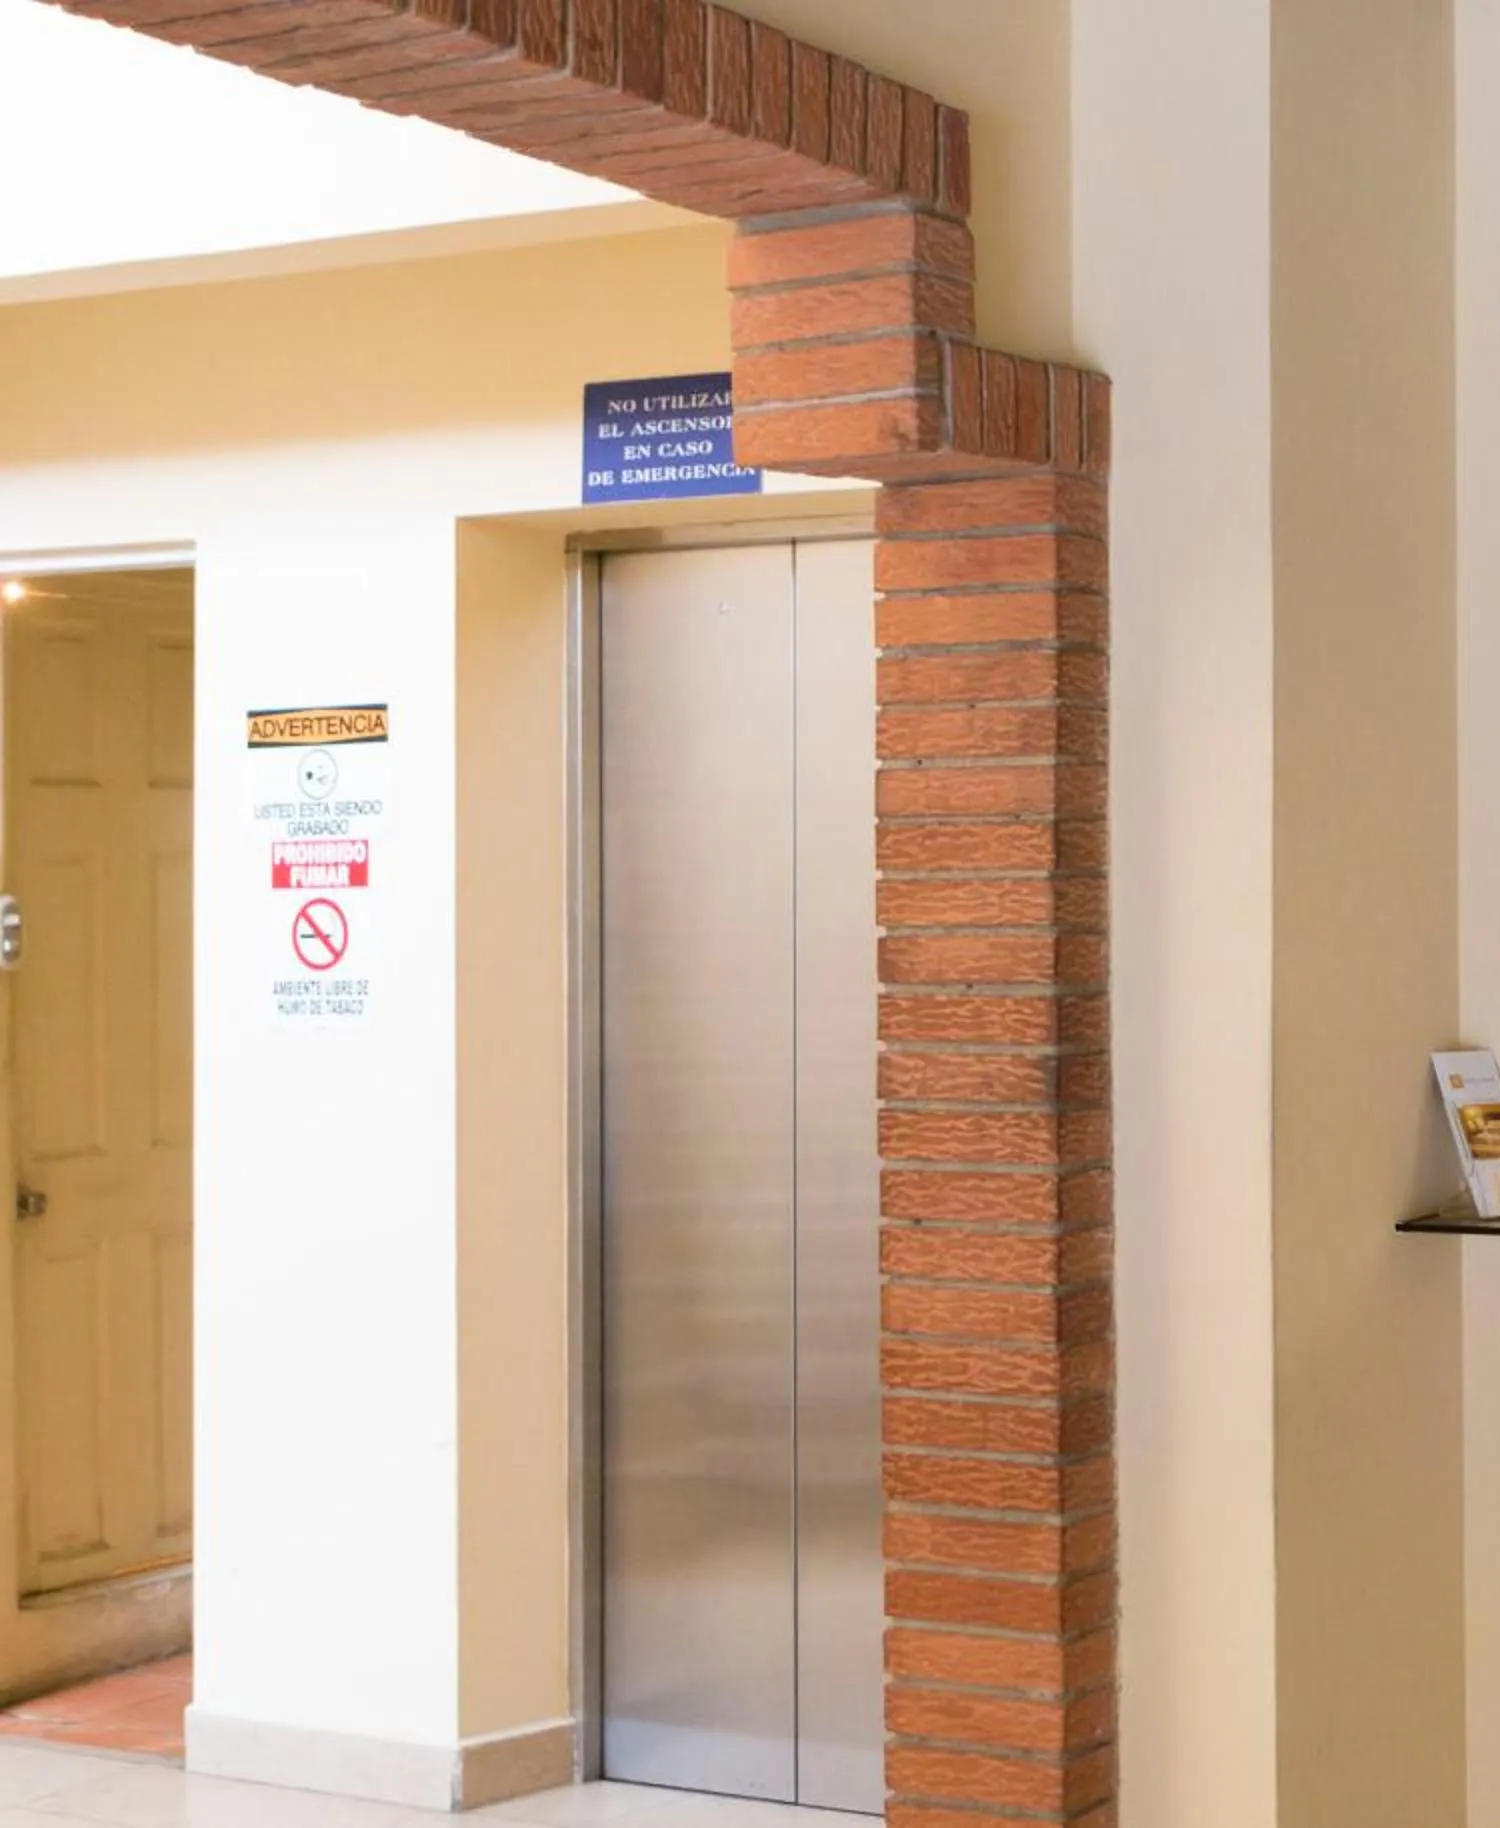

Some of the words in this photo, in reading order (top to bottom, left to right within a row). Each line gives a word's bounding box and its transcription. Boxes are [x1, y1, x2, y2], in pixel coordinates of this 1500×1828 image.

[607, 399, 637, 415] NO
[598, 424, 624, 439] EL
[623, 446, 651, 461] EN
[657, 440, 713, 457] CASO
[587, 471, 614, 487] DE
[621, 463, 756, 485] EMERGENCIA
[250, 711, 386, 739] ADVERTENCIA
[253, 803, 295, 819] USTED
[299, 801, 330, 817] ESTA
[335, 799, 383, 816] SIENDO
[287, 819, 349, 836] GRABADO
[273, 841, 367, 865] PROHIBIDO
[289, 864, 350, 887] FUMAR
